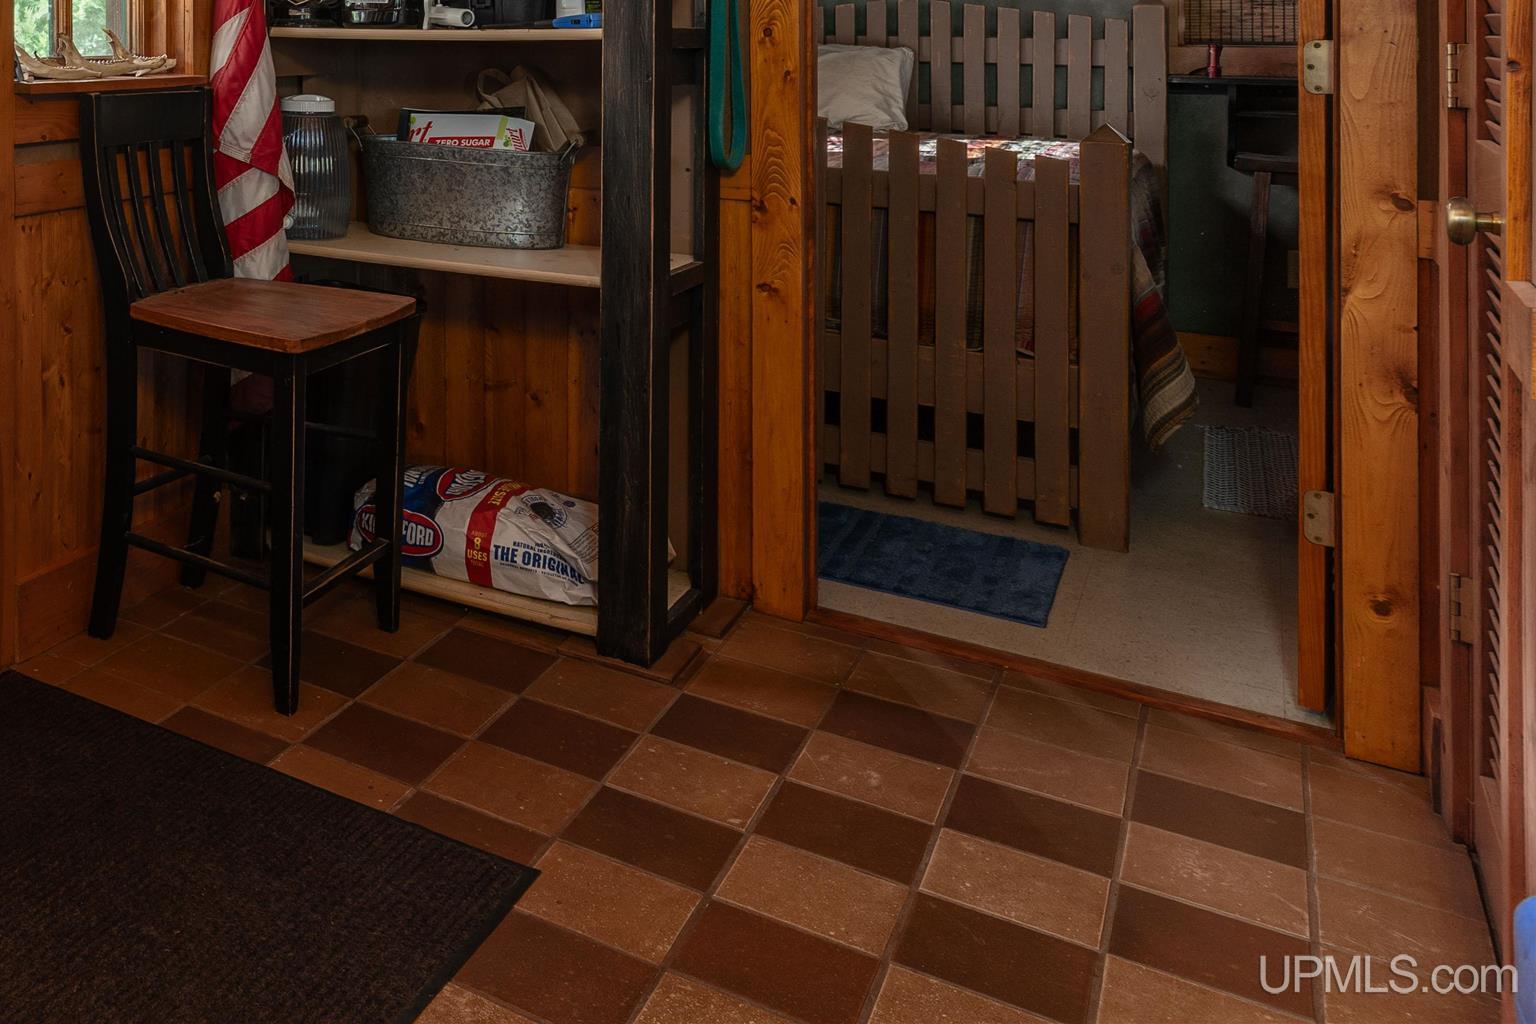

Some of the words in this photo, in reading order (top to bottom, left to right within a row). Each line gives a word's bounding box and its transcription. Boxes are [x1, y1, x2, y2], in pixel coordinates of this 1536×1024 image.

[460, 138, 491, 147] SUGAR
[473, 537, 481, 550] 8
[467, 549, 488, 562] USES
[493, 544, 518, 564] THE
